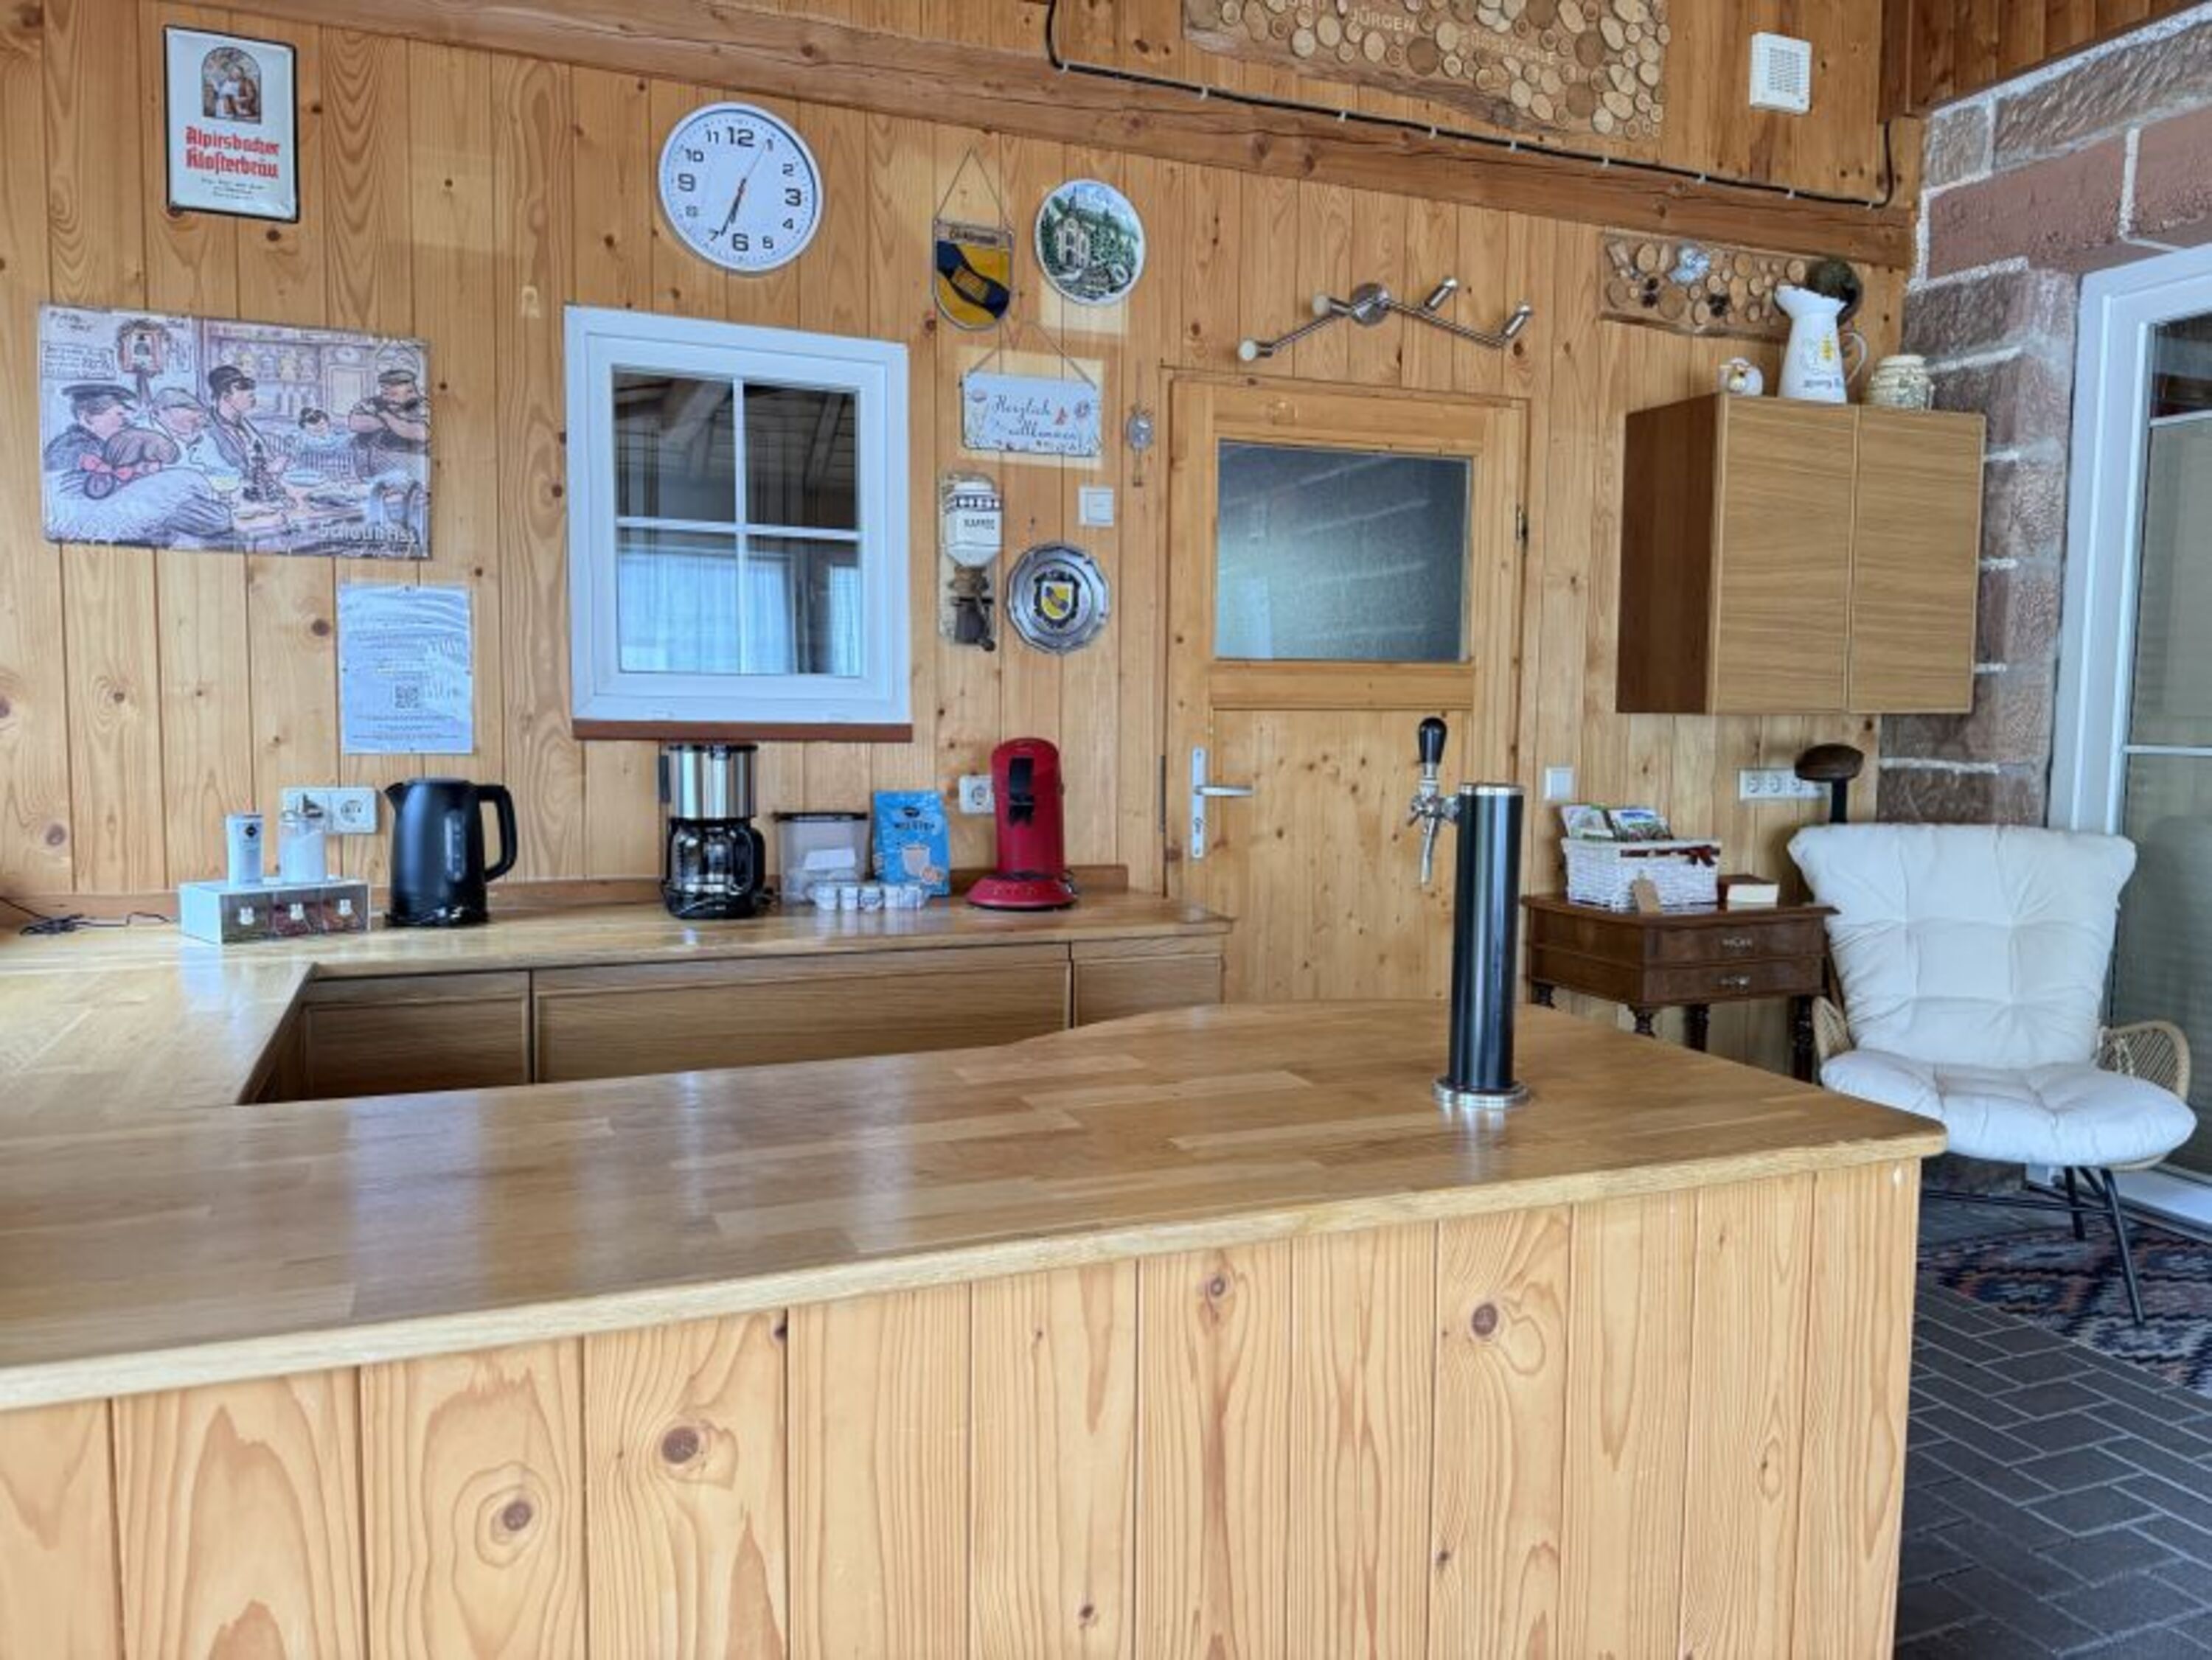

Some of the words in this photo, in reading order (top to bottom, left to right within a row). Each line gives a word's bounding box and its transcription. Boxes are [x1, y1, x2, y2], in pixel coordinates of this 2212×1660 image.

[186, 126, 279, 156] Alpirsbacher
[706, 130, 719, 144] 11
[728, 127, 754, 147] 12
[766, 139, 773, 151] 1
[685, 148, 705, 162] 10
[782, 164, 794, 176] 2
[678, 173, 696, 192] 9
[785, 188, 802, 206] 3
[782, 218, 794, 229] 4
[709, 229, 720, 241] 7
[732, 233, 749, 251] 6
